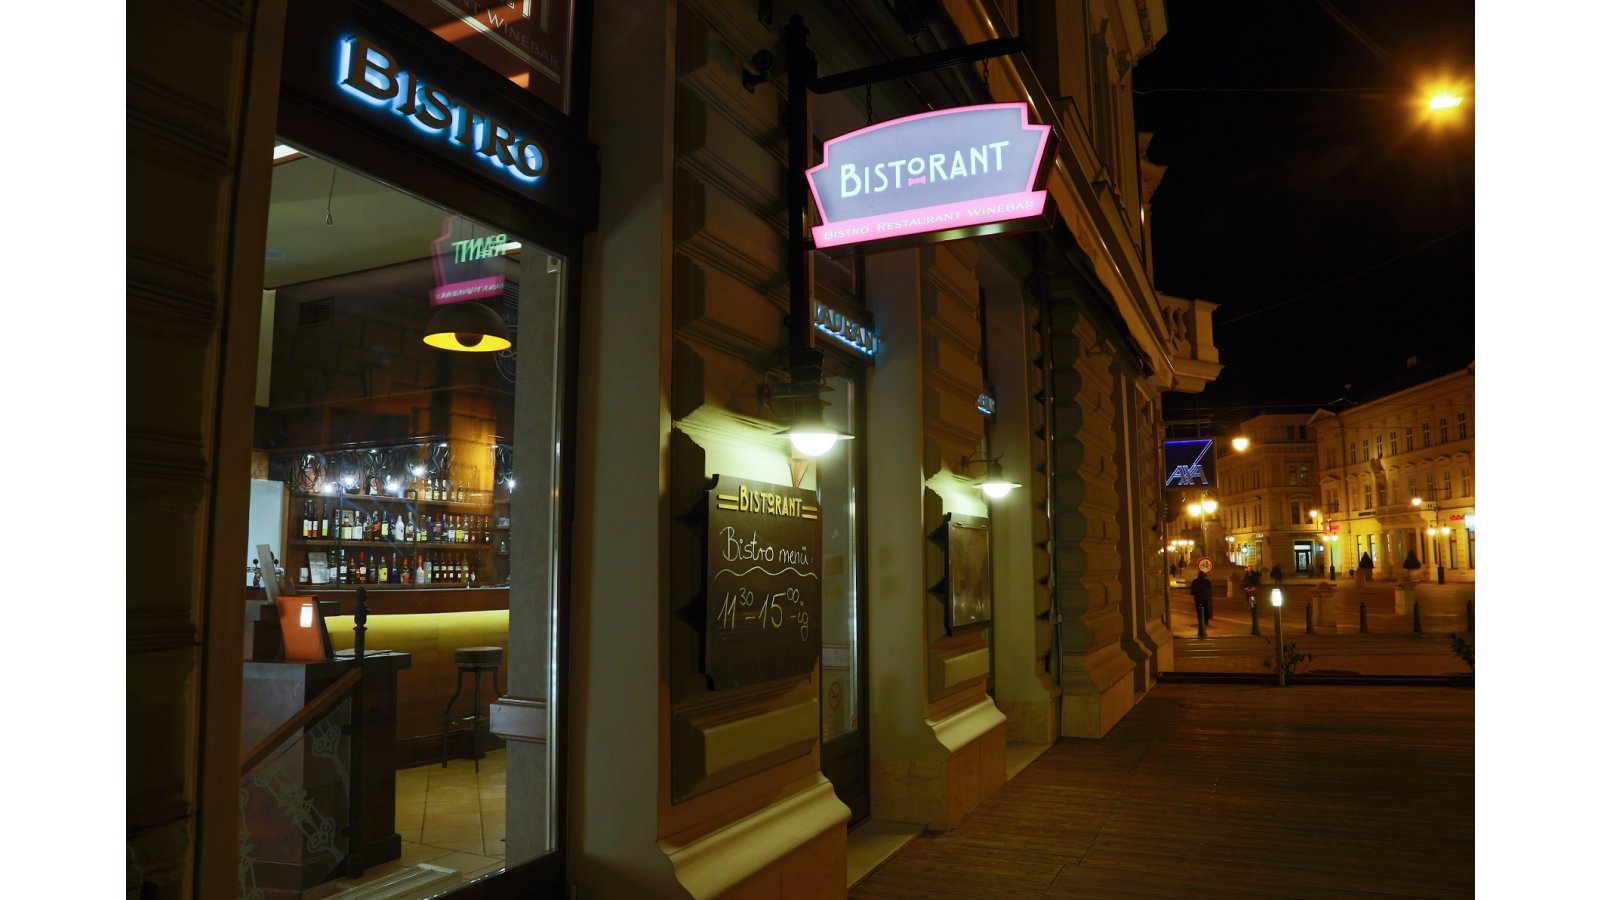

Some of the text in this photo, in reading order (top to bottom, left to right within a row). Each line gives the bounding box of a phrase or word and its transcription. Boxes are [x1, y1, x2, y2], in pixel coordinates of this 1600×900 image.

[487, 8, 559, 69] WINEBAR
[342, 34, 550, 179] BISTRO
[839, 140, 1010, 198] BISTORANT
[823, 199, 1035, 241] BISTRO RESTAURANT WINEBAR
[1165, 464, 1209, 487] AXA
[739, 485, 802, 517] BISTORANT
[719, 526, 775, 562] Bistro
